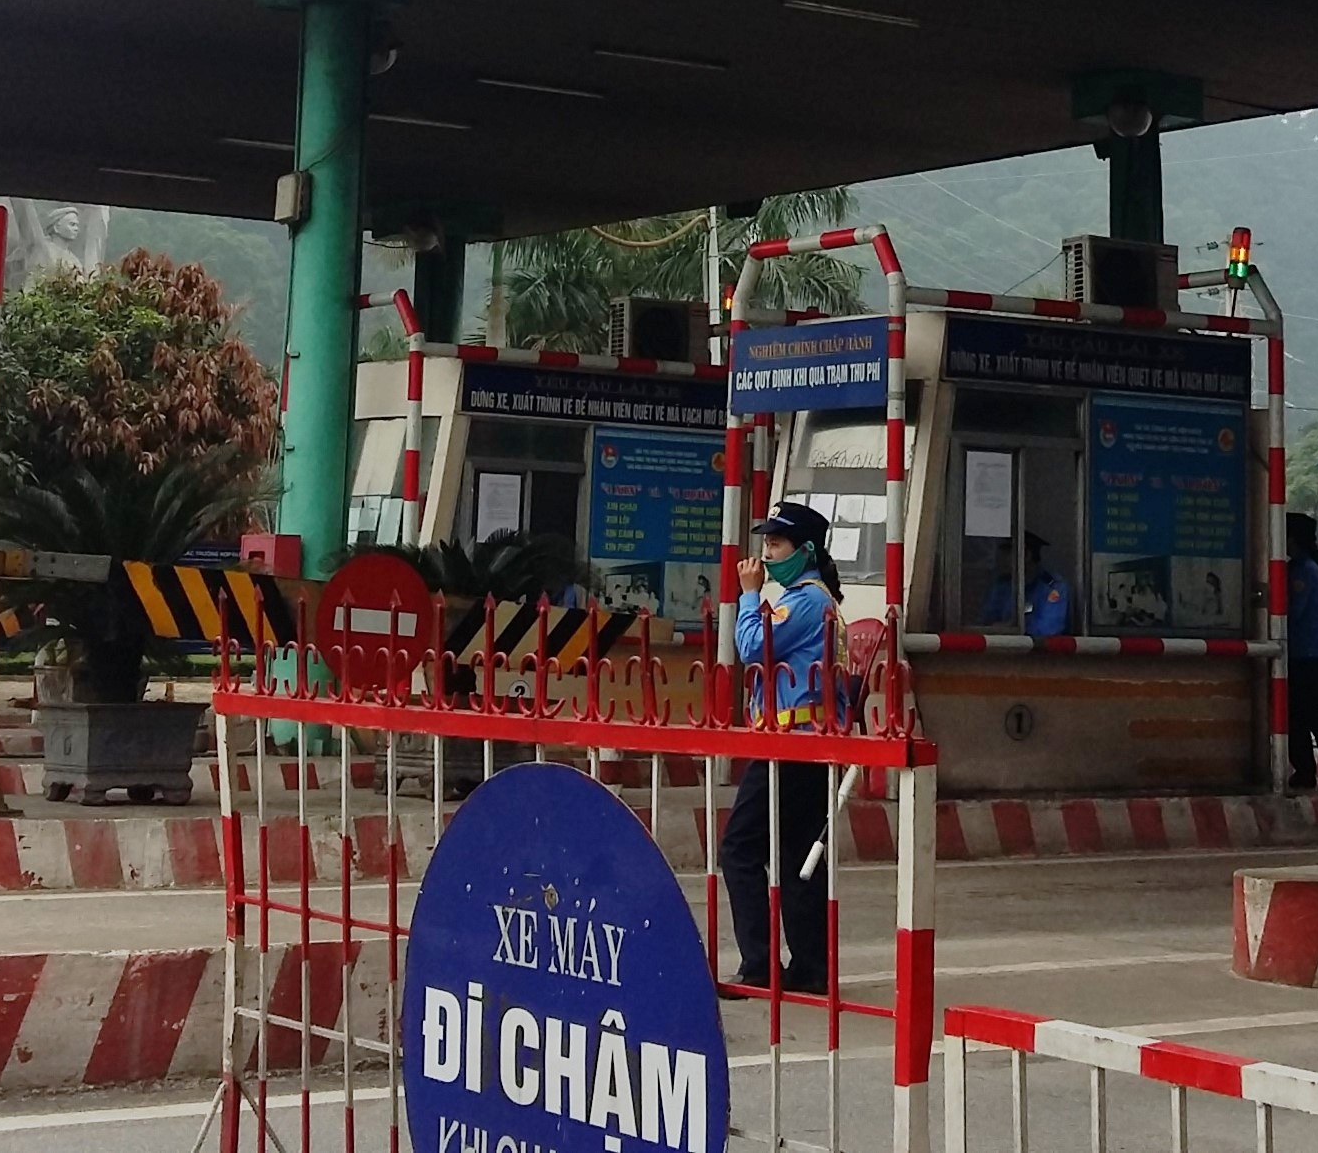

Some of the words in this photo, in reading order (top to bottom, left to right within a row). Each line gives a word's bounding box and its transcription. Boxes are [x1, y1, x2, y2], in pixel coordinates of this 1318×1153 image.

[736, 367, 753, 391] CÁC
[754, 369, 771, 392] QUY
[772, 368, 792, 392] ĐỊNH
[793, 367, 807, 387] KHI
[808, 365, 825, 388] QUA
[826, 363, 848, 388] TRẠM
[850, 362, 865, 383] THU
[867, 357, 881, 381] PHÍ
[492, 904, 538, 970] XE
[547, 897, 627, 987] MÁY
[499, 1008, 707, 1153] CHẬM
